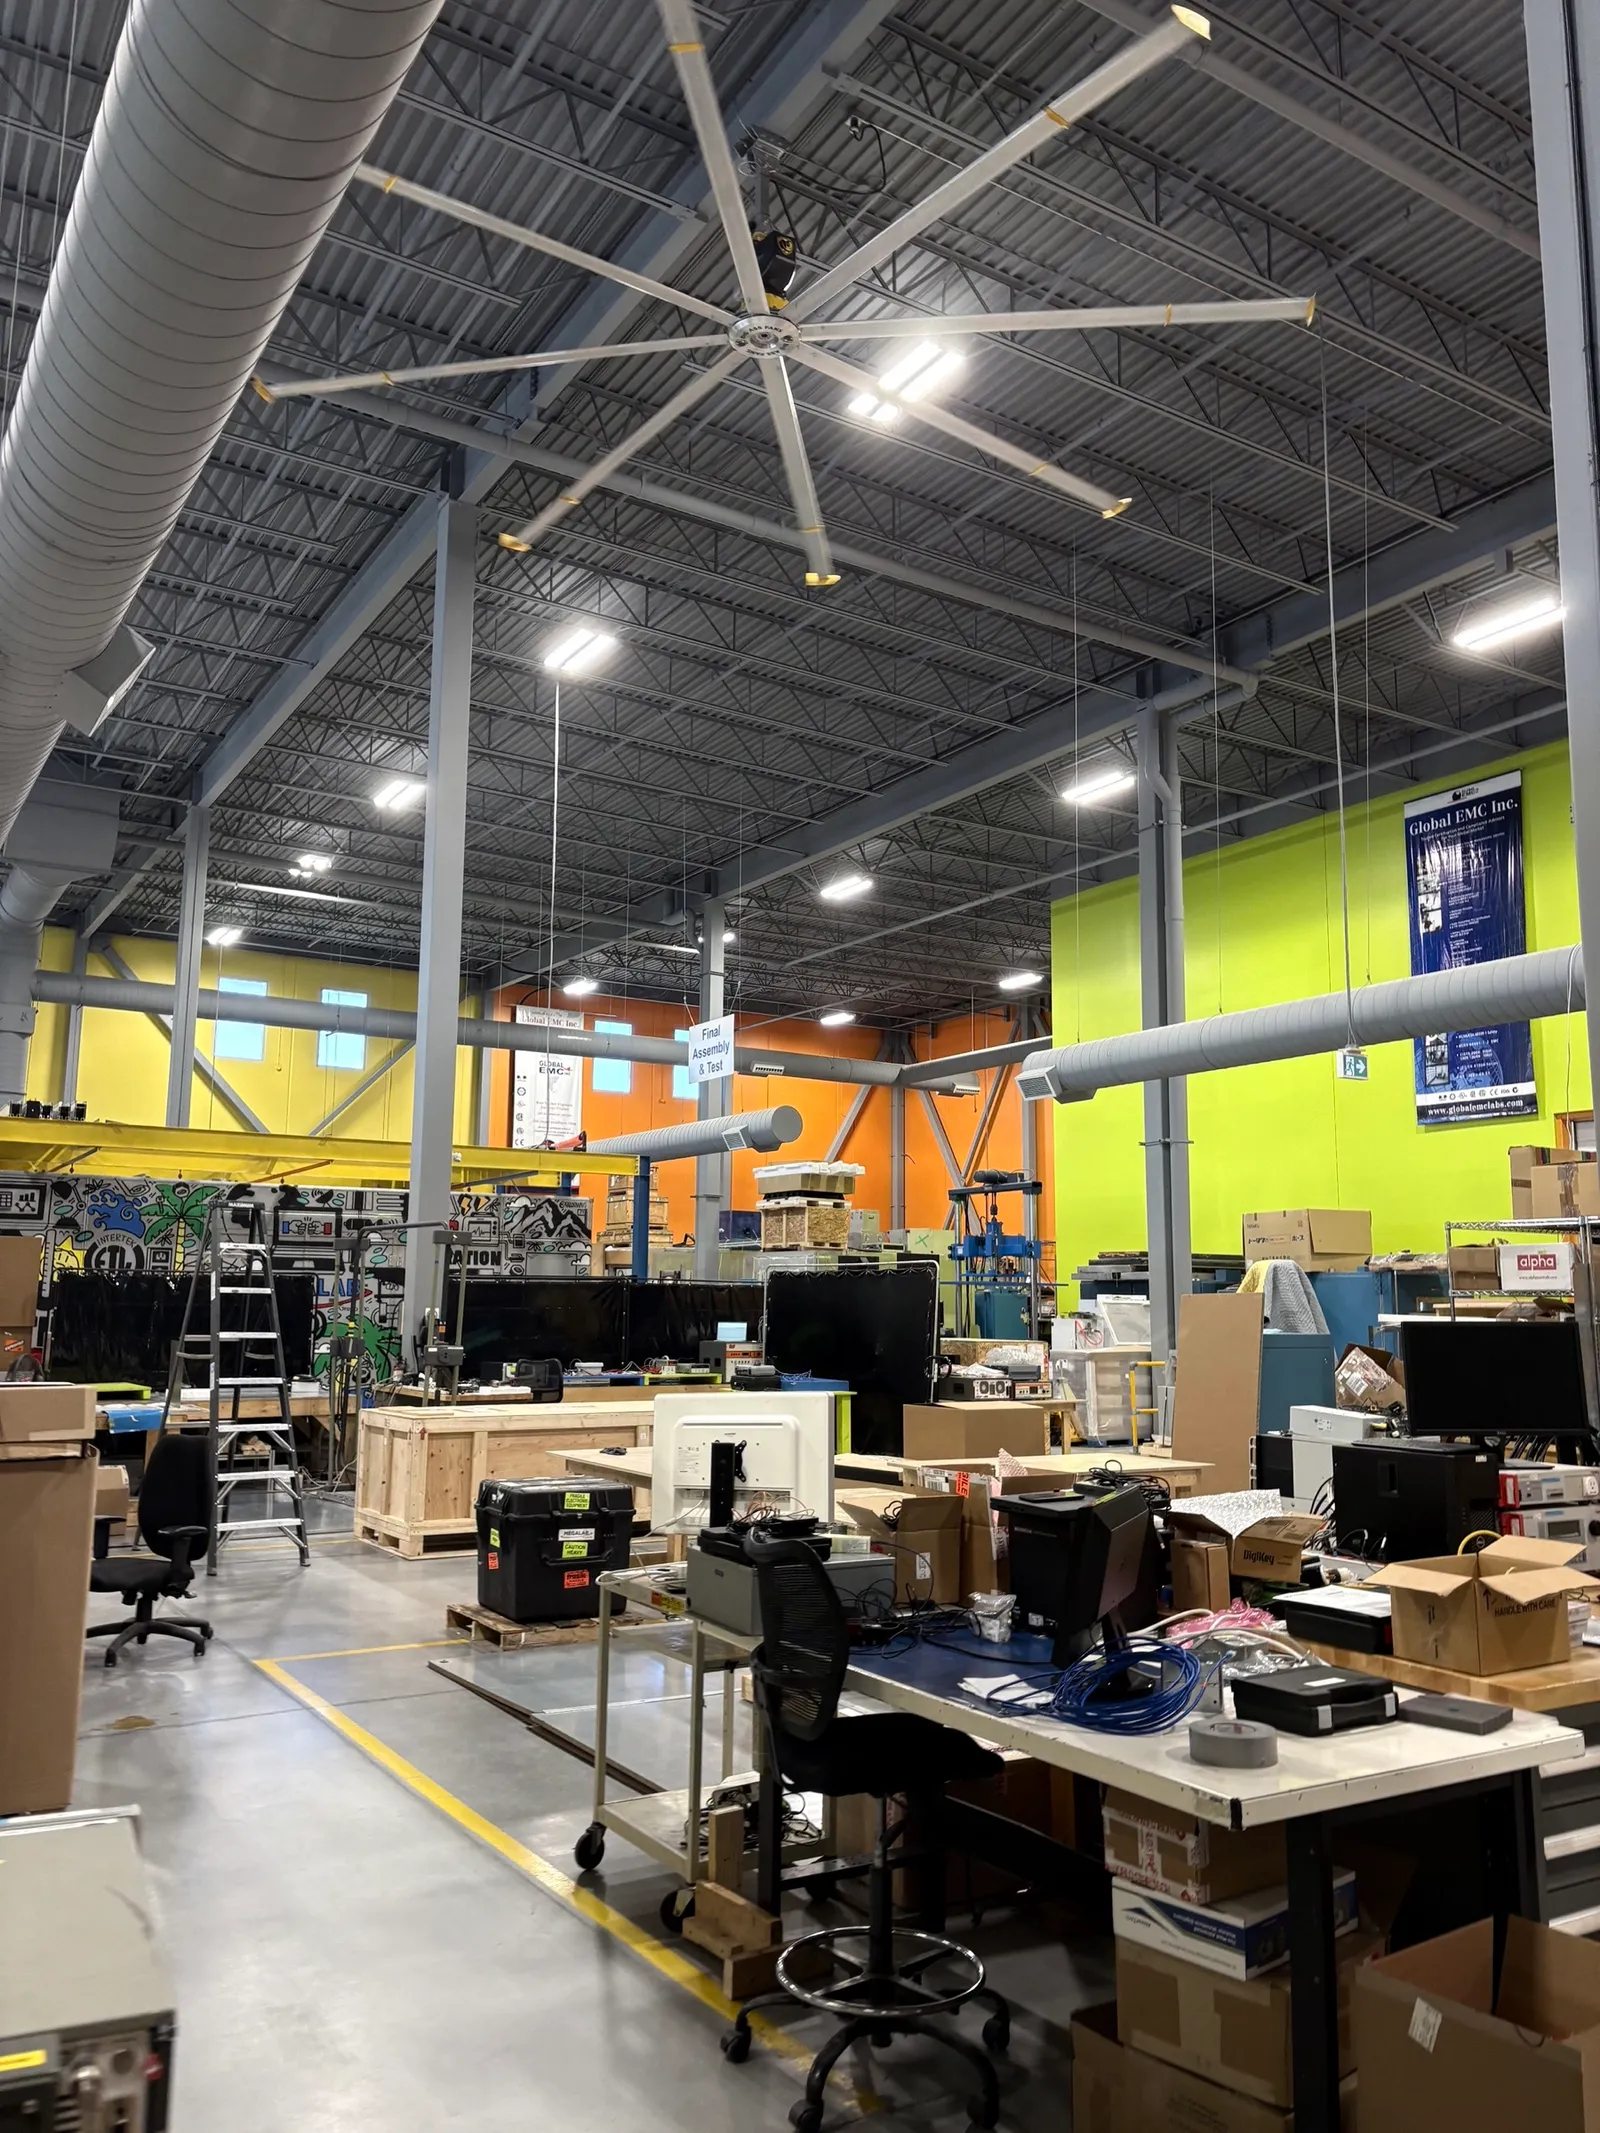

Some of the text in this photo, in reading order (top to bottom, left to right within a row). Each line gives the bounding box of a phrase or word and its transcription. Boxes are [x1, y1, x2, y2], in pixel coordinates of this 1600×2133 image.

[1409, 798, 1518, 836] Global EMC Inc.
[702, 1024, 721, 1041] Final
[692, 1041, 730, 1060] Assembly
[539, 1066, 564, 1074] EMC
[699, 1060, 723, 1076] & Test
[1427, 1099, 1524, 1116] www.globalemclabs.com
[97, 1233, 137, 1249] INTERTEK
[450, 1250, 502, 1266] ATION
[1520, 1254, 1554, 1273] alpha
[1243, 1550, 1275, 1566] DigiKey
[1494, 1598, 1556, 1617] HANDLE WITH CARE
